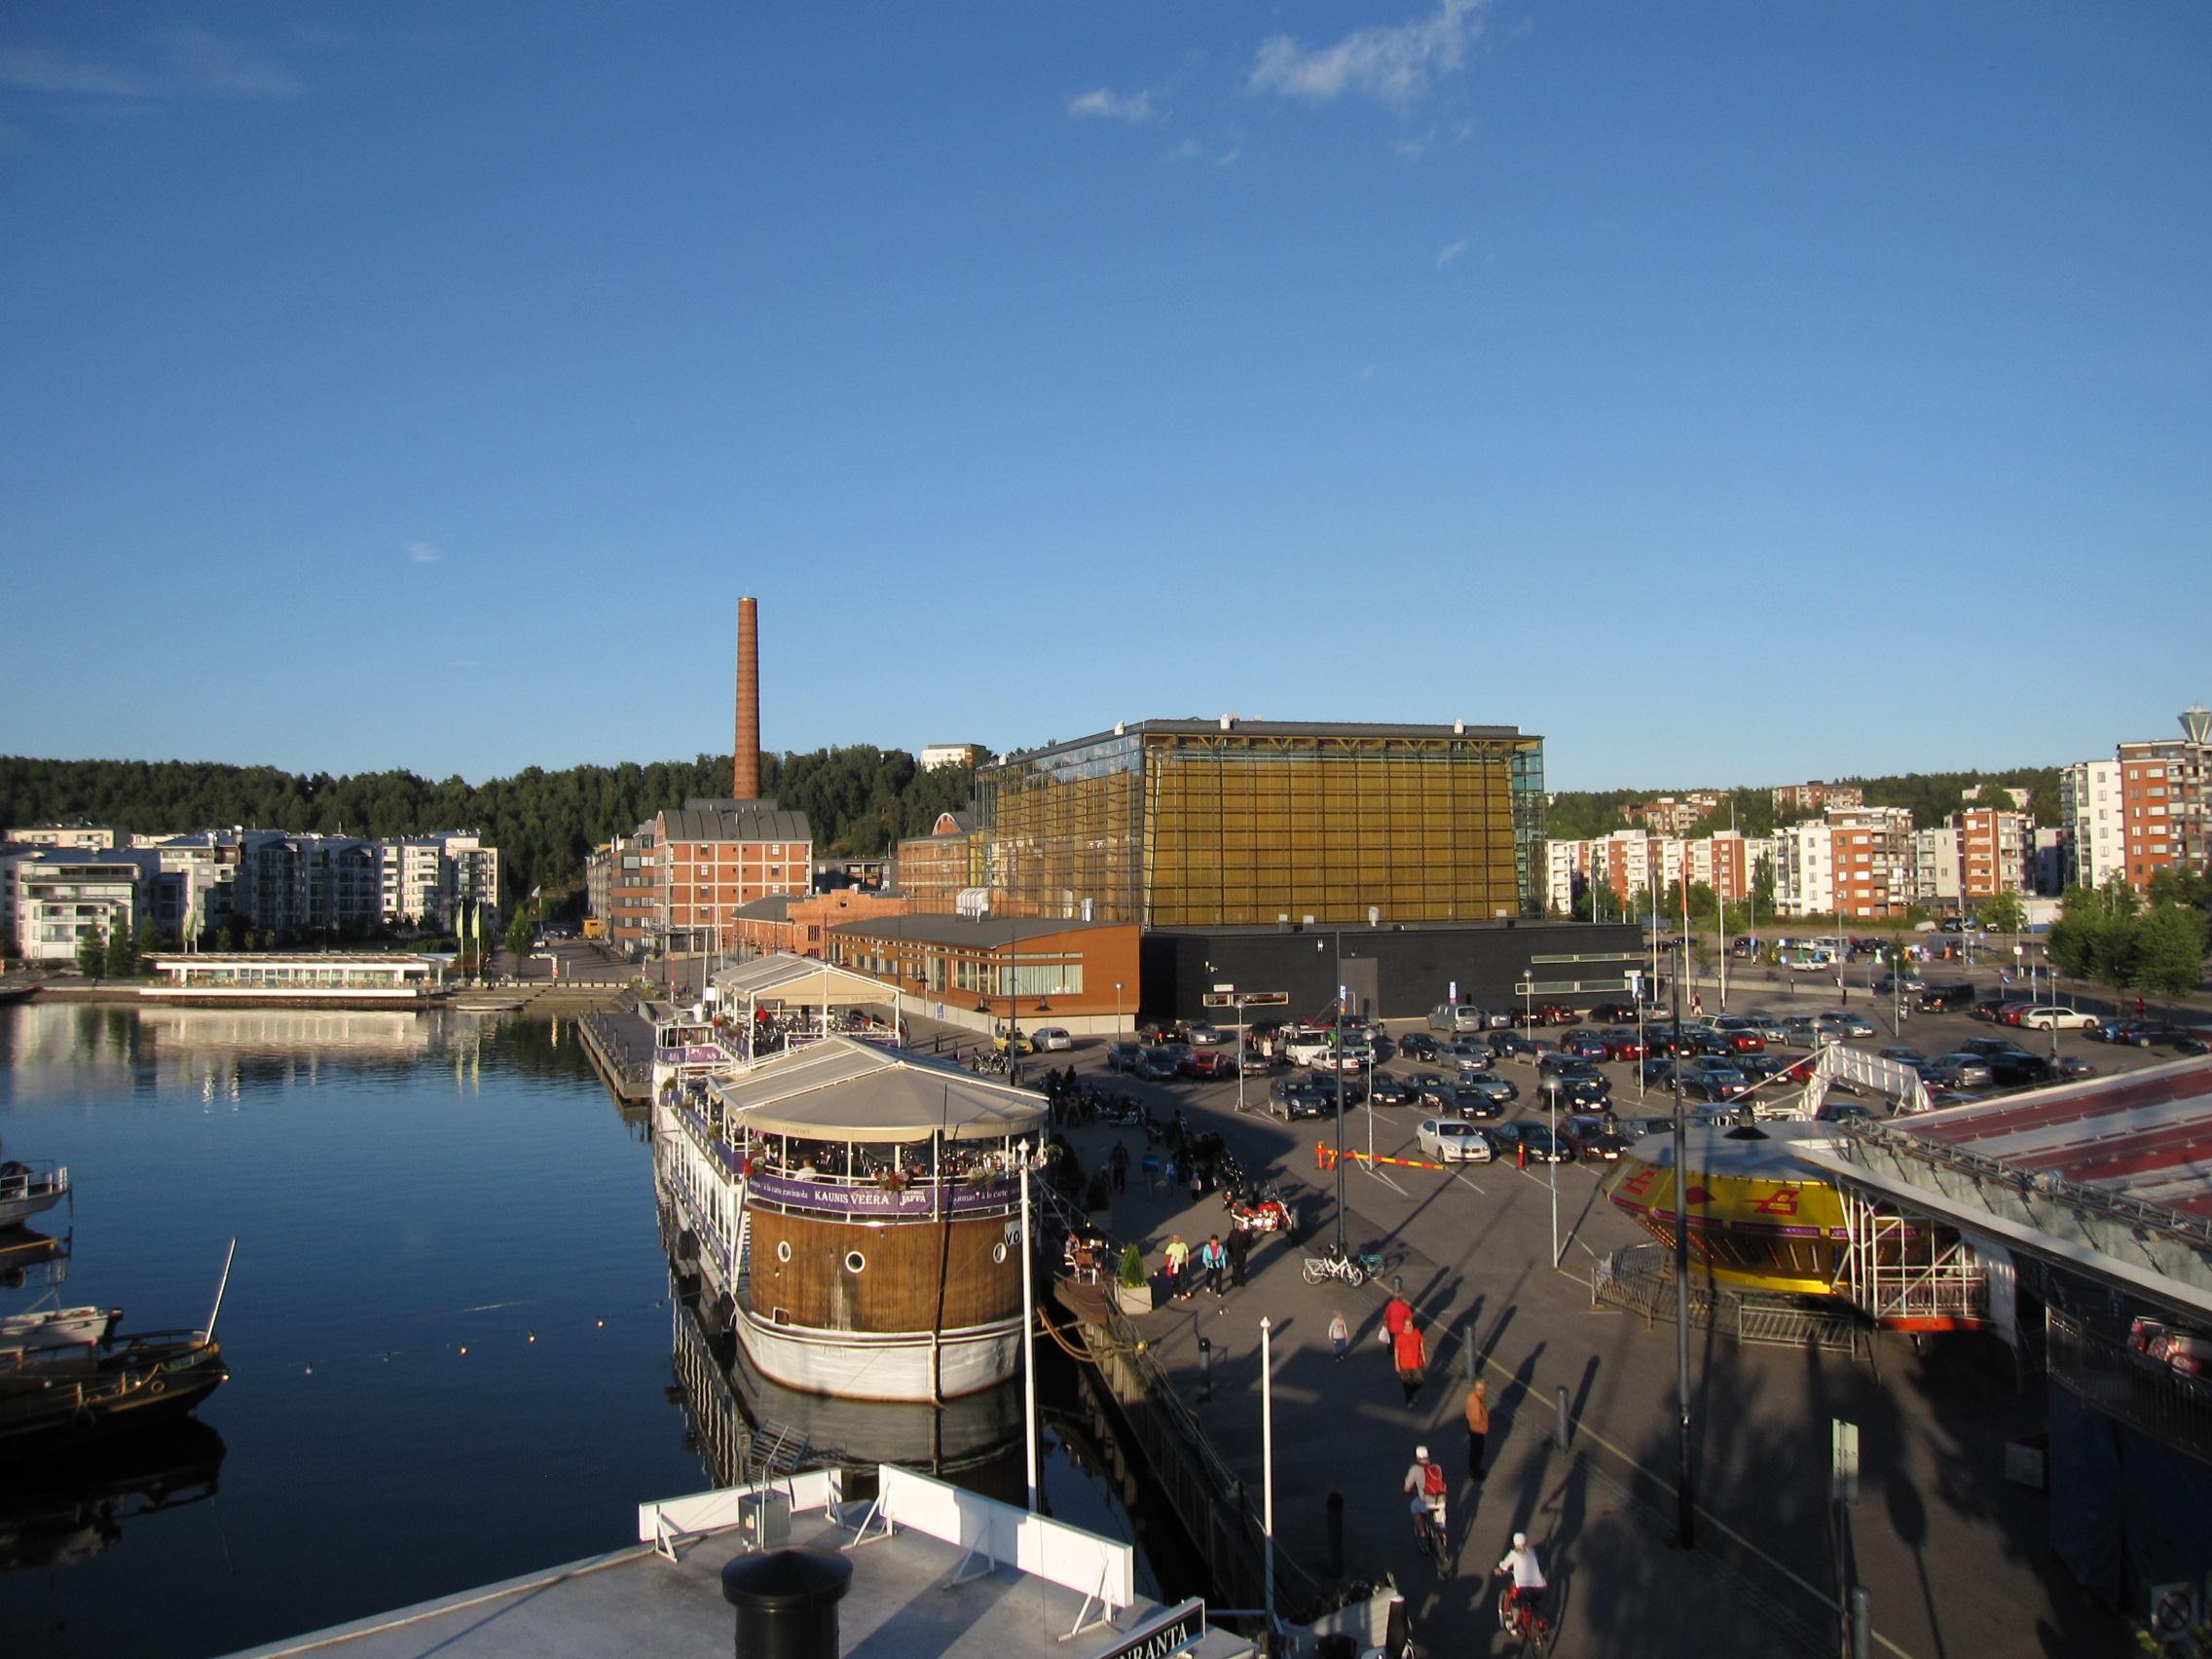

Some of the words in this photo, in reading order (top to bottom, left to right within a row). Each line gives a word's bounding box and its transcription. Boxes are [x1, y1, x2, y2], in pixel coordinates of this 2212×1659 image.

[814, 1191, 849, 1203] KAUNIS
[850, 1194, 890, 1205] VEERA
[899, 1195, 927, 1206] JAFFA
